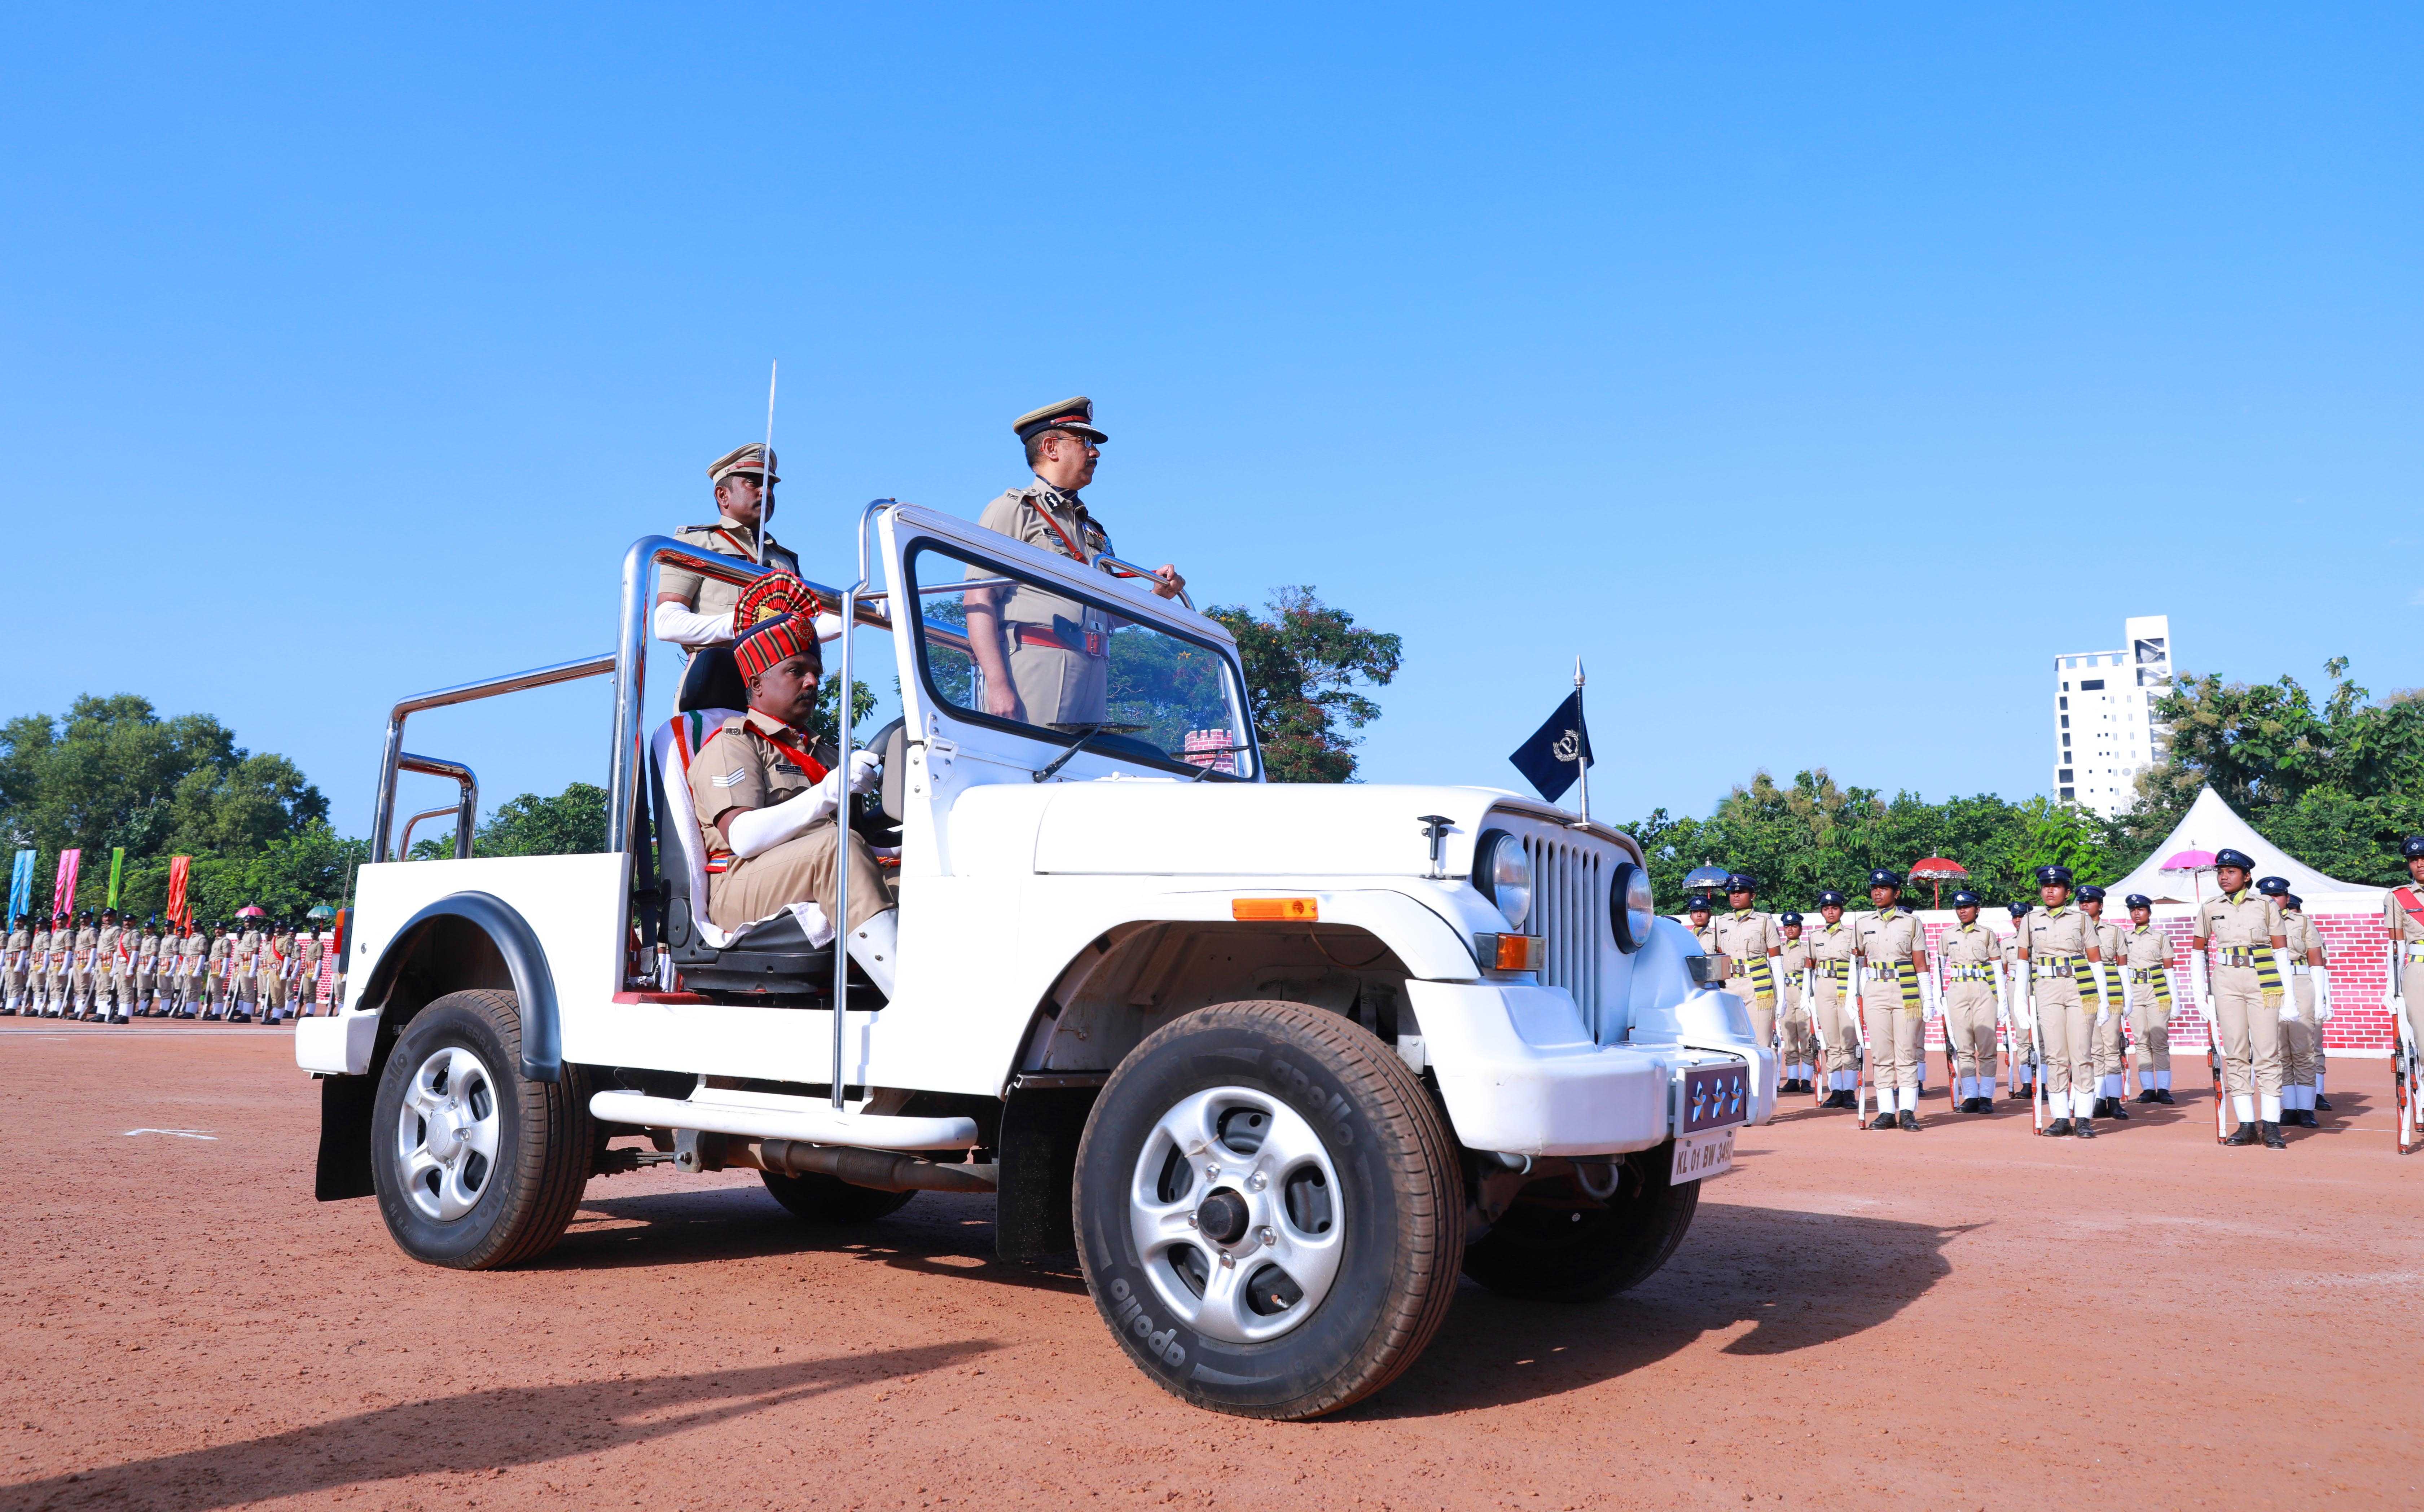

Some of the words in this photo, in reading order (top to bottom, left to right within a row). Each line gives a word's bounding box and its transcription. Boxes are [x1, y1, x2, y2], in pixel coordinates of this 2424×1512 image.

[1269, 1059, 1354, 1146] apollo
[1676, 1151, 1687, 1175] KL
[1691, 1148, 1700, 1172] 01
[1703, 1143, 1716, 1168] BW
[388, 1203, 397, 1217] 16
[396, 1217, 404, 1227] R
[1110, 1278, 1186, 1367] apollo
